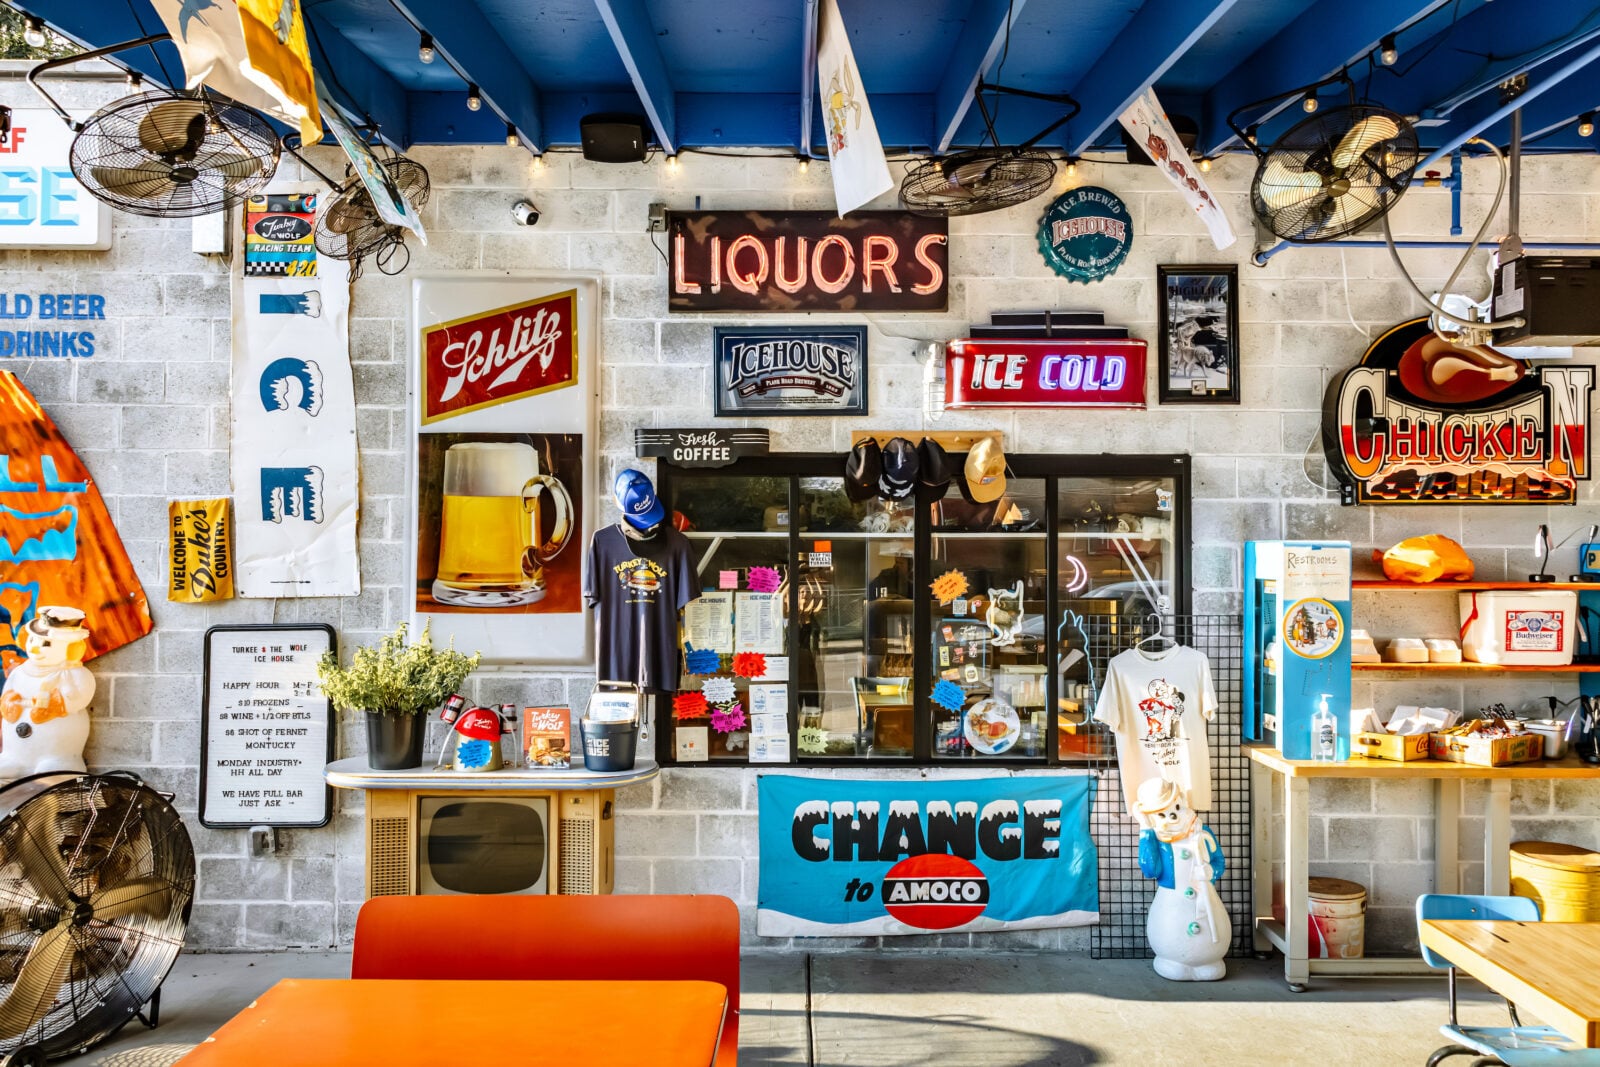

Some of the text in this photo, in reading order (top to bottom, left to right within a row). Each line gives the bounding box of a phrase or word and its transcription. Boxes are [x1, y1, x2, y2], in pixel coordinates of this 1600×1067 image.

[1057, 191, 1121, 214] ICE BREWED
[1052, 216, 1126, 247] ICEHOUSE
[254, 244, 284, 252] RACING
[286, 260, 317, 277] 420
[675, 234, 948, 295] LIQUORS
[39, 294, 106, 320] BEER
[0, 331, 95, 358] DRINKS
[440, 308, 562, 403] Schlitz
[728, 340, 855, 391] ICEHOUSE
[971, 354, 1127, 391] ICE COLD
[1339, 366, 1593, 481] CHICKEN
[678, 432, 725, 446] Fresh
[673, 447, 731, 461] COFFEE
[174, 515, 187, 591] WELCOME TO
[190, 504, 216, 600] Duke's
[613, 558, 668, 577] TURKEY WOLF
[532, 710, 560, 723] Turkey
[538, 721, 564, 730] WOLF
[792, 800, 1063, 862] CHANGE
[844, 878, 874, 902] to
[889, 881, 981, 902] AMOCO
